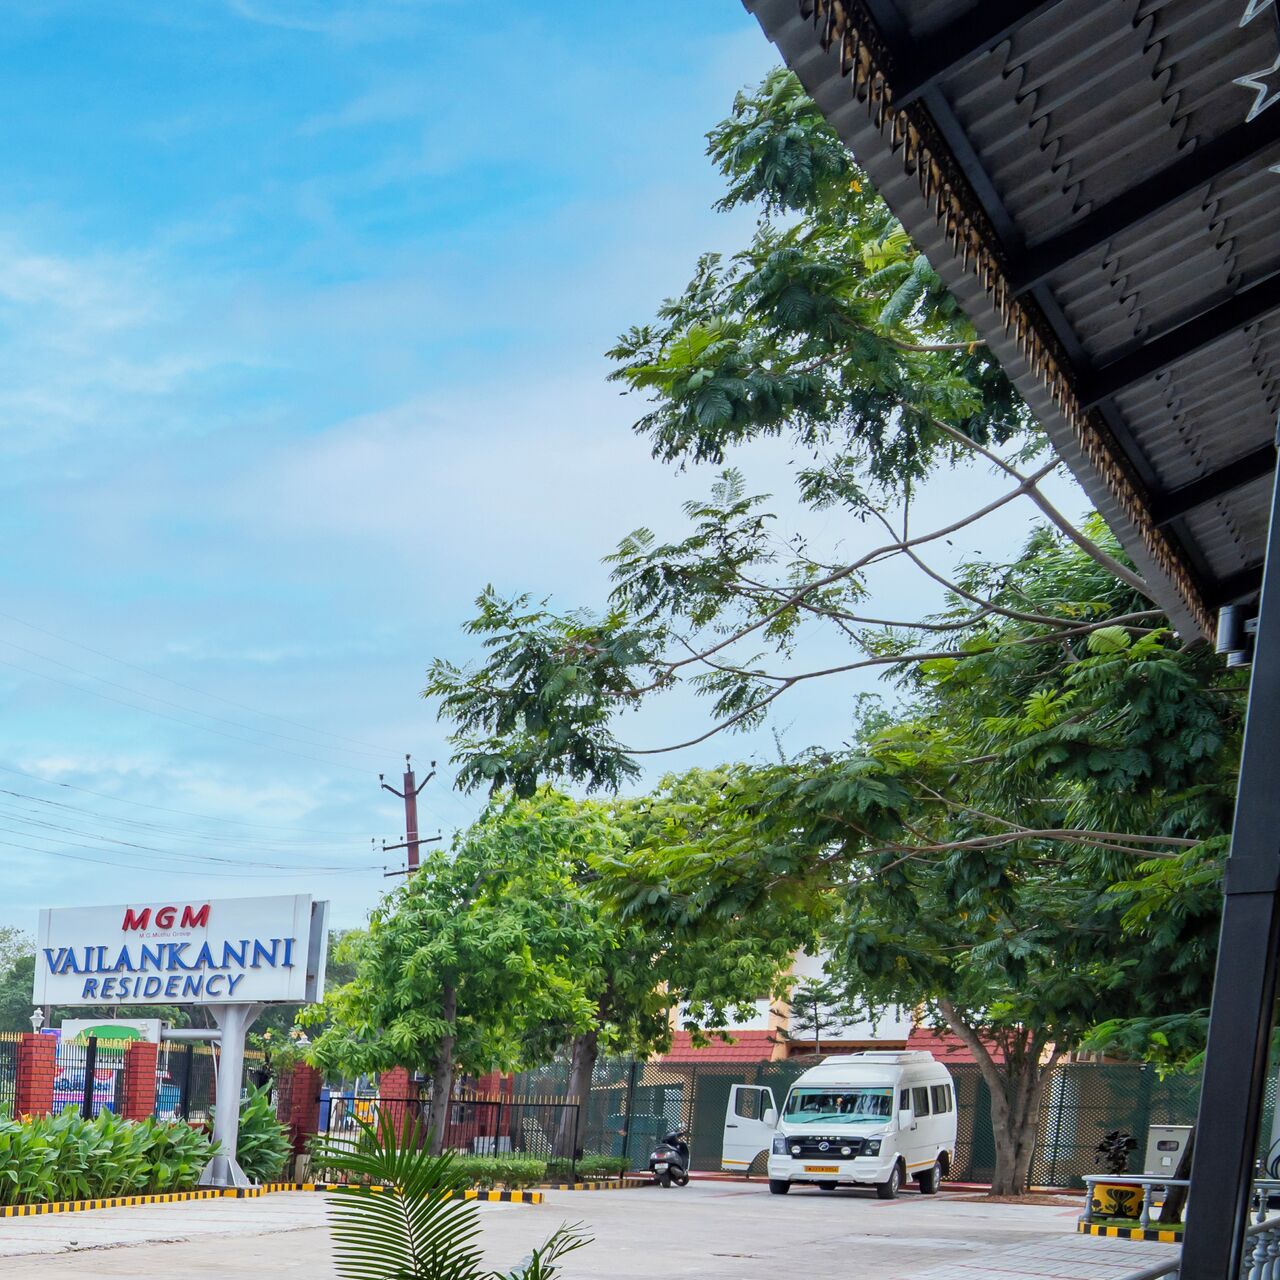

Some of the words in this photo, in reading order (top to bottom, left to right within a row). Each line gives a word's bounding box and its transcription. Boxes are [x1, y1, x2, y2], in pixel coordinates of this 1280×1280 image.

[122, 904, 211, 932] MGM
[43, 937, 296, 974] VAILANKANNI
[81, 973, 244, 999] RESIDENCY
